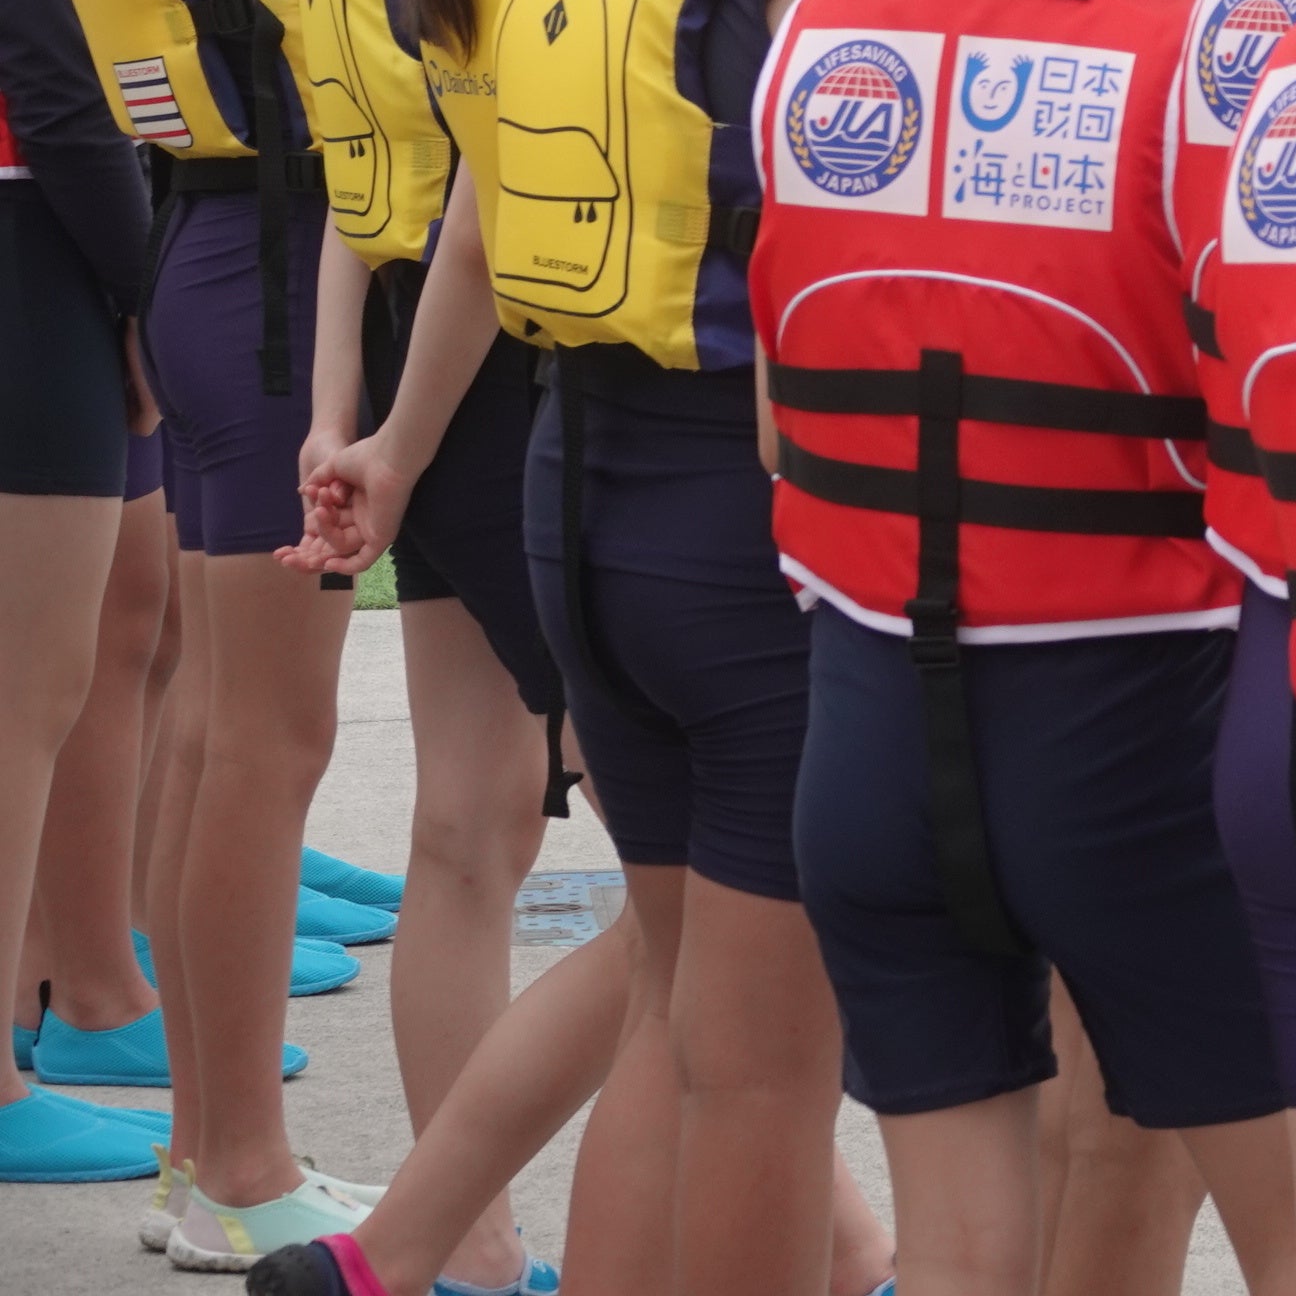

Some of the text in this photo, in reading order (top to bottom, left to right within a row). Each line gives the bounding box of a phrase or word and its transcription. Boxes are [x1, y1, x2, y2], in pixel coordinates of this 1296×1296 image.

[814, 44, 907, 83] LIFESAVING
[1038, 57, 1123, 96] 日本
[815, 171, 879, 193] JAPAN
[1009, 194, 1105, 215] PROJECT
[533, 254, 589, 275] BLUESTORM
